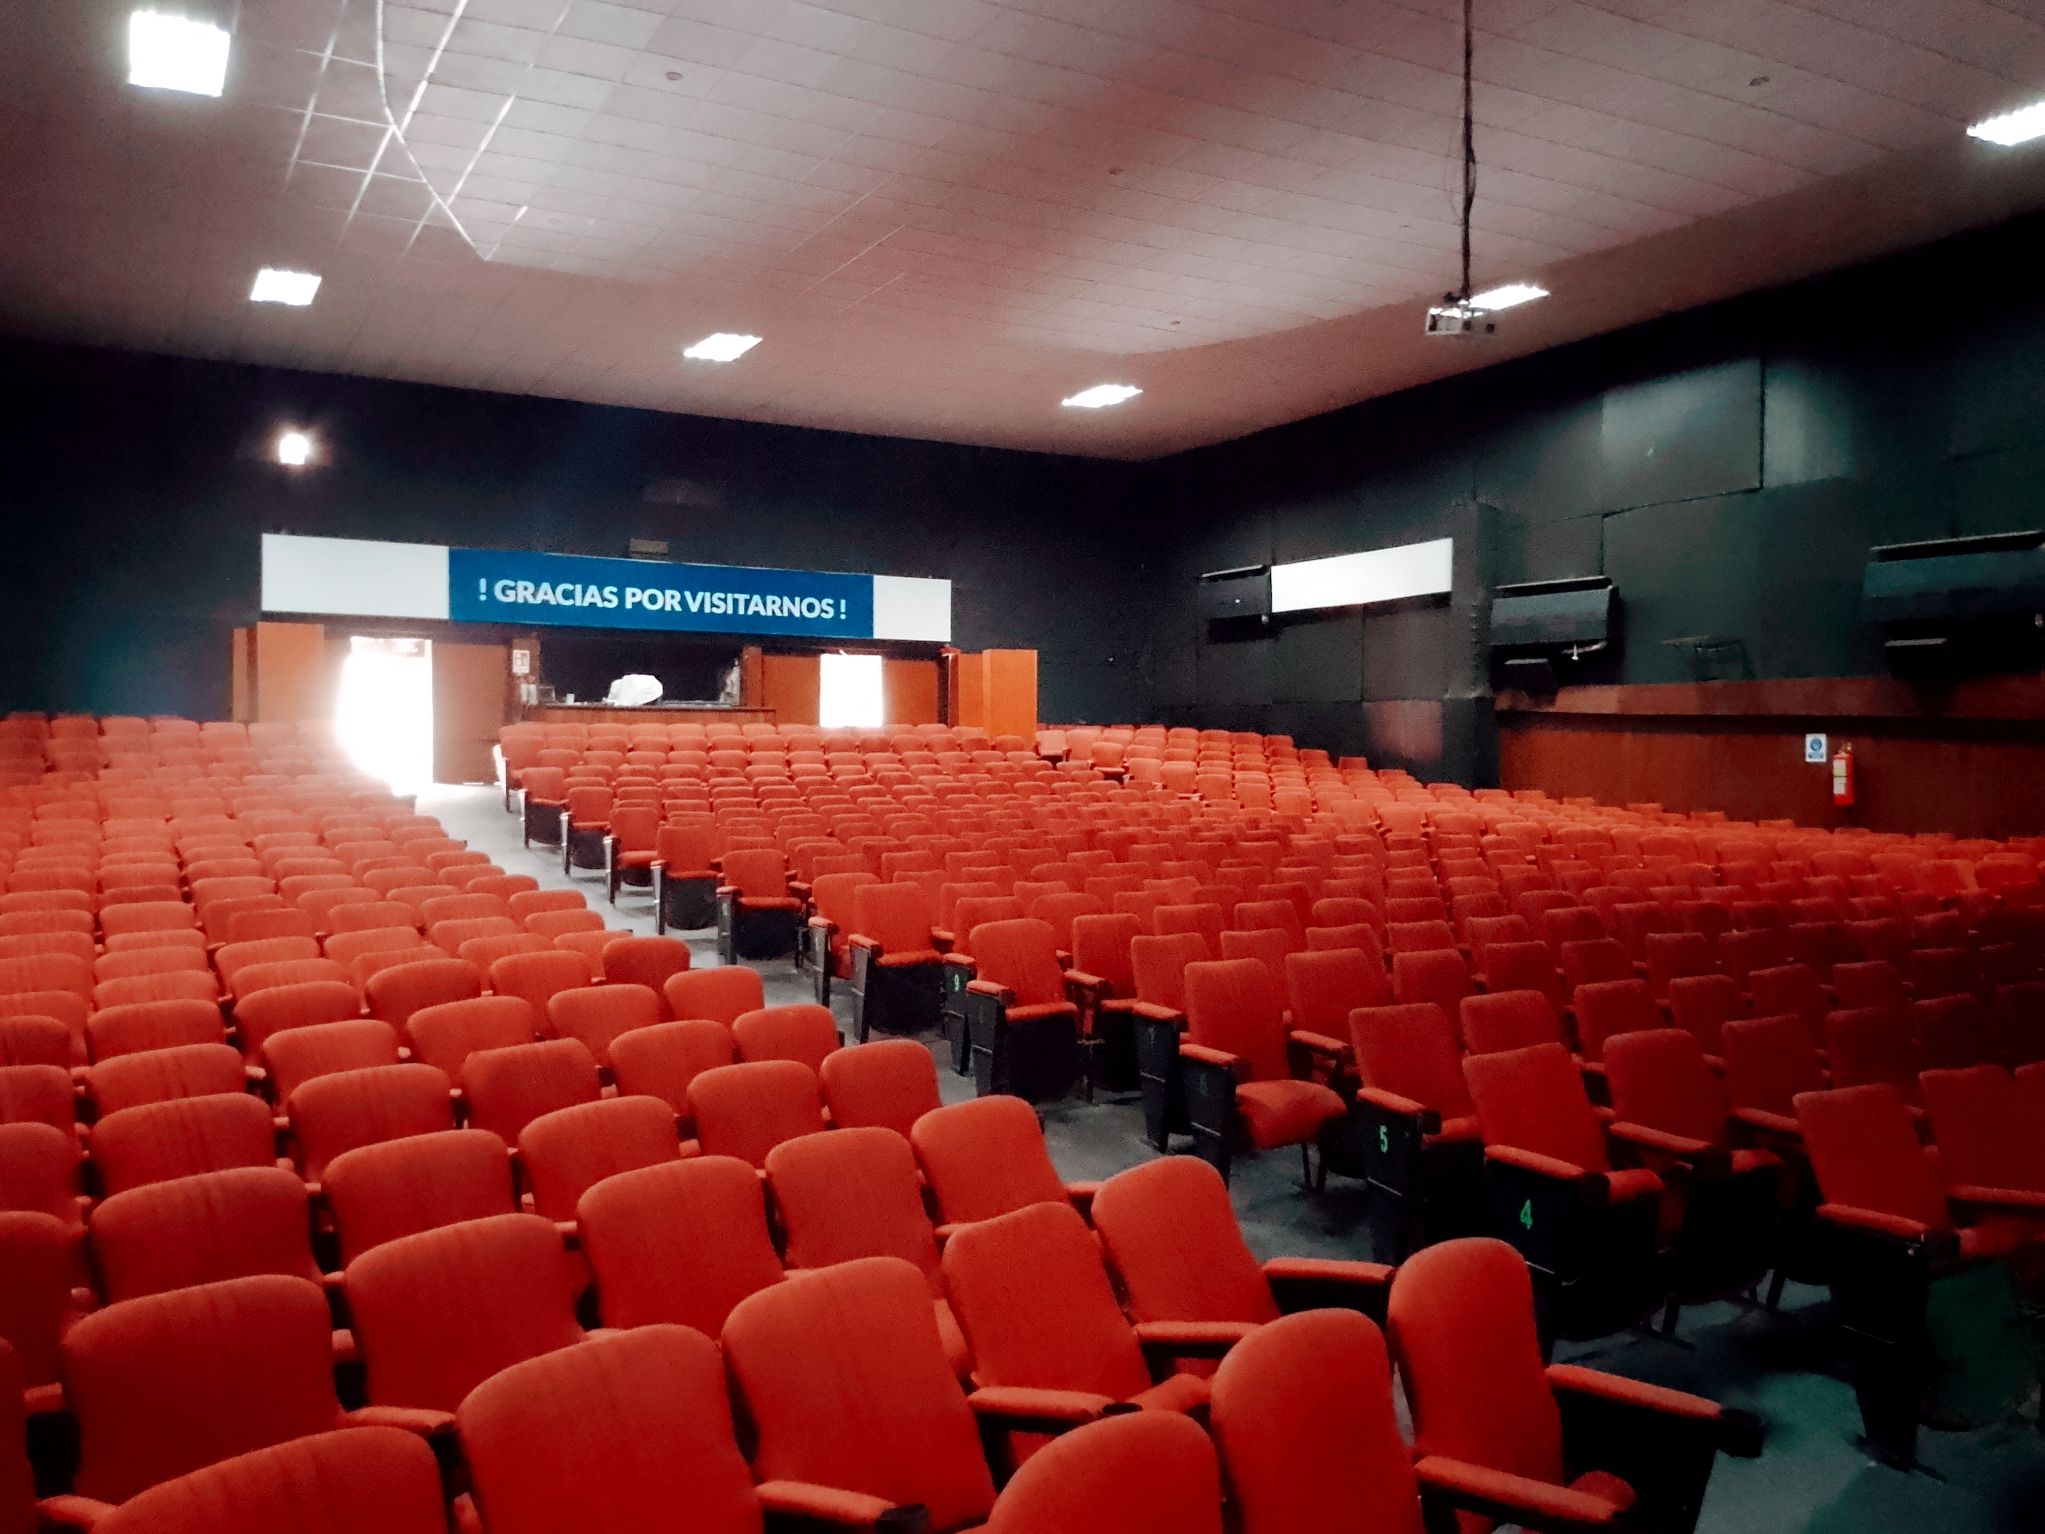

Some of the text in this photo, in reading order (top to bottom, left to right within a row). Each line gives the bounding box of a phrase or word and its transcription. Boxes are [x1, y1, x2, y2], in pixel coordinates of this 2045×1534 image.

[494, 579, 619, 609] GRACIAS
[625, 587, 683, 612] POR
[684, 590, 835, 619] VISITARNOS
[1379, 1125, 1389, 1154] 5
[1519, 1198, 1533, 1231] 4
